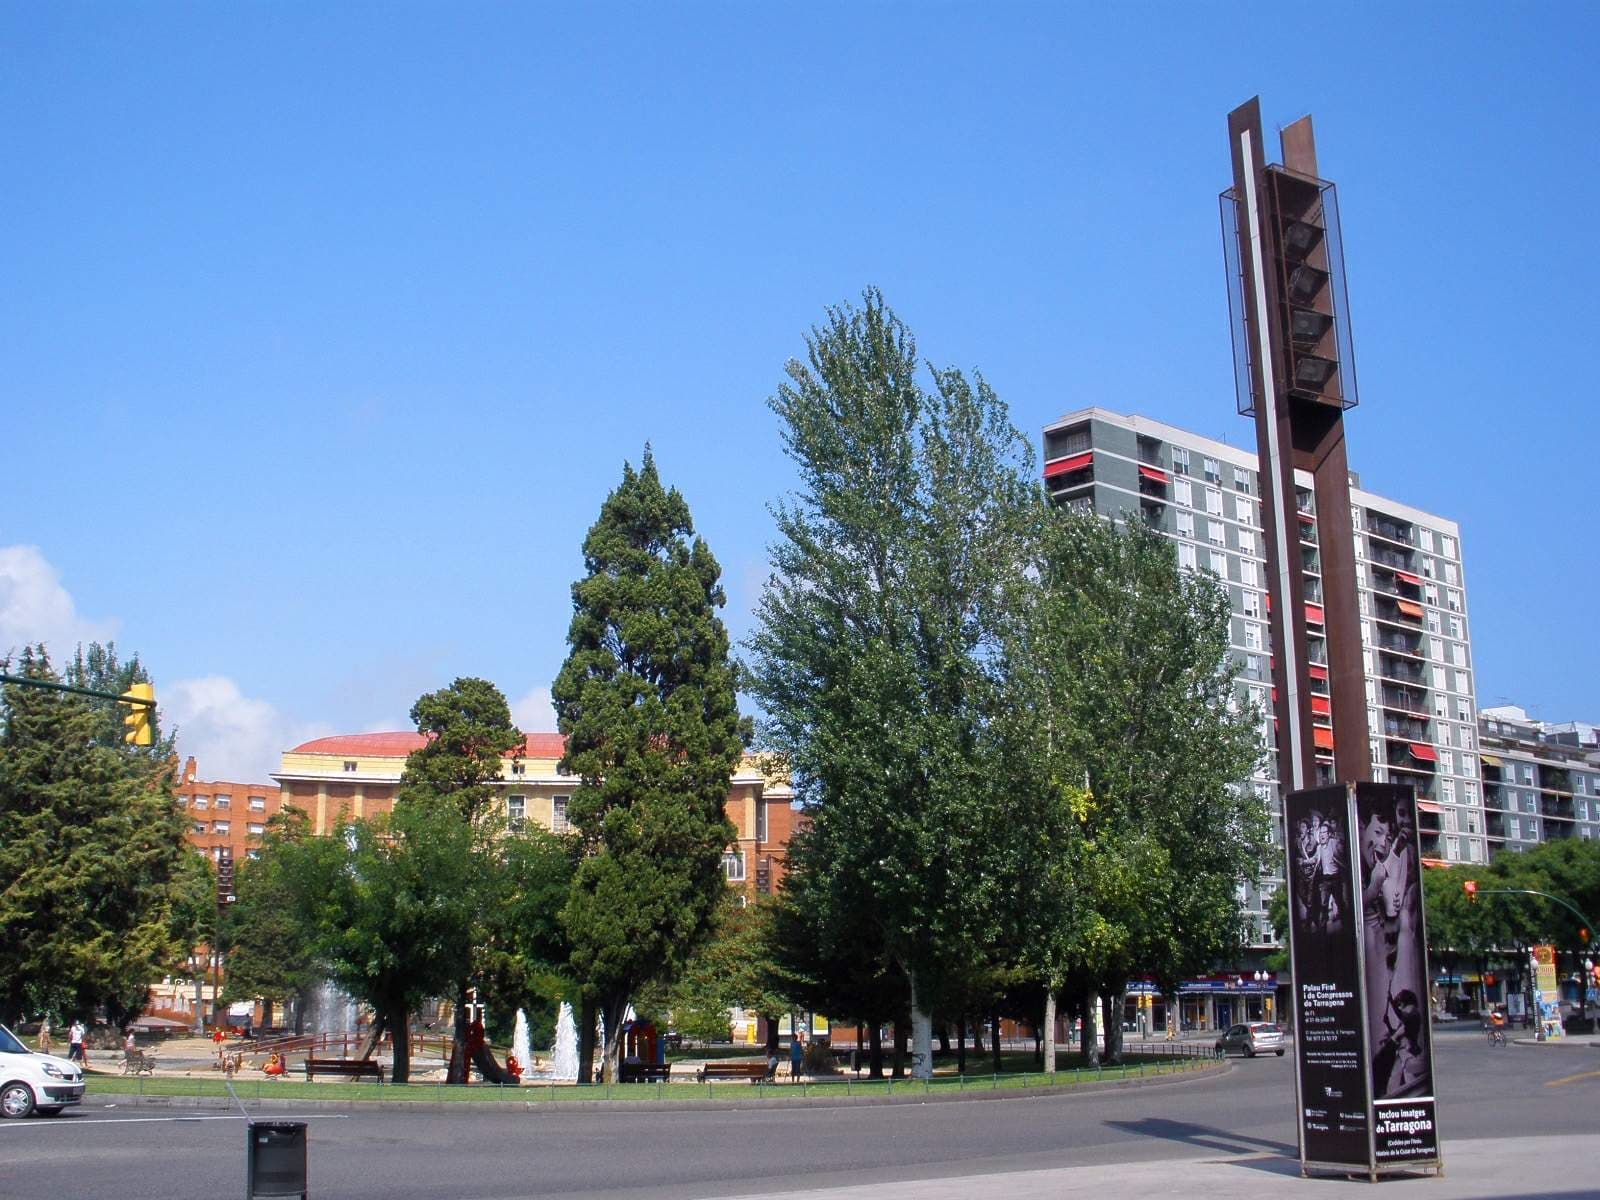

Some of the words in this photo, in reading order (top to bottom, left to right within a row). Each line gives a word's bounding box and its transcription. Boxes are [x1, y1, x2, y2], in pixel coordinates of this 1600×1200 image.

[1316, 992, 1352, 1000] Congressos
[1313, 1000, 1344, 1008] Tarragona
[1379, 1110, 1400, 1119] Inclou
[1400, 1109, 1426, 1118] imatges
[1376, 1125, 1384, 1133] de
[1384, 1120, 1432, 1134] Tarragona
